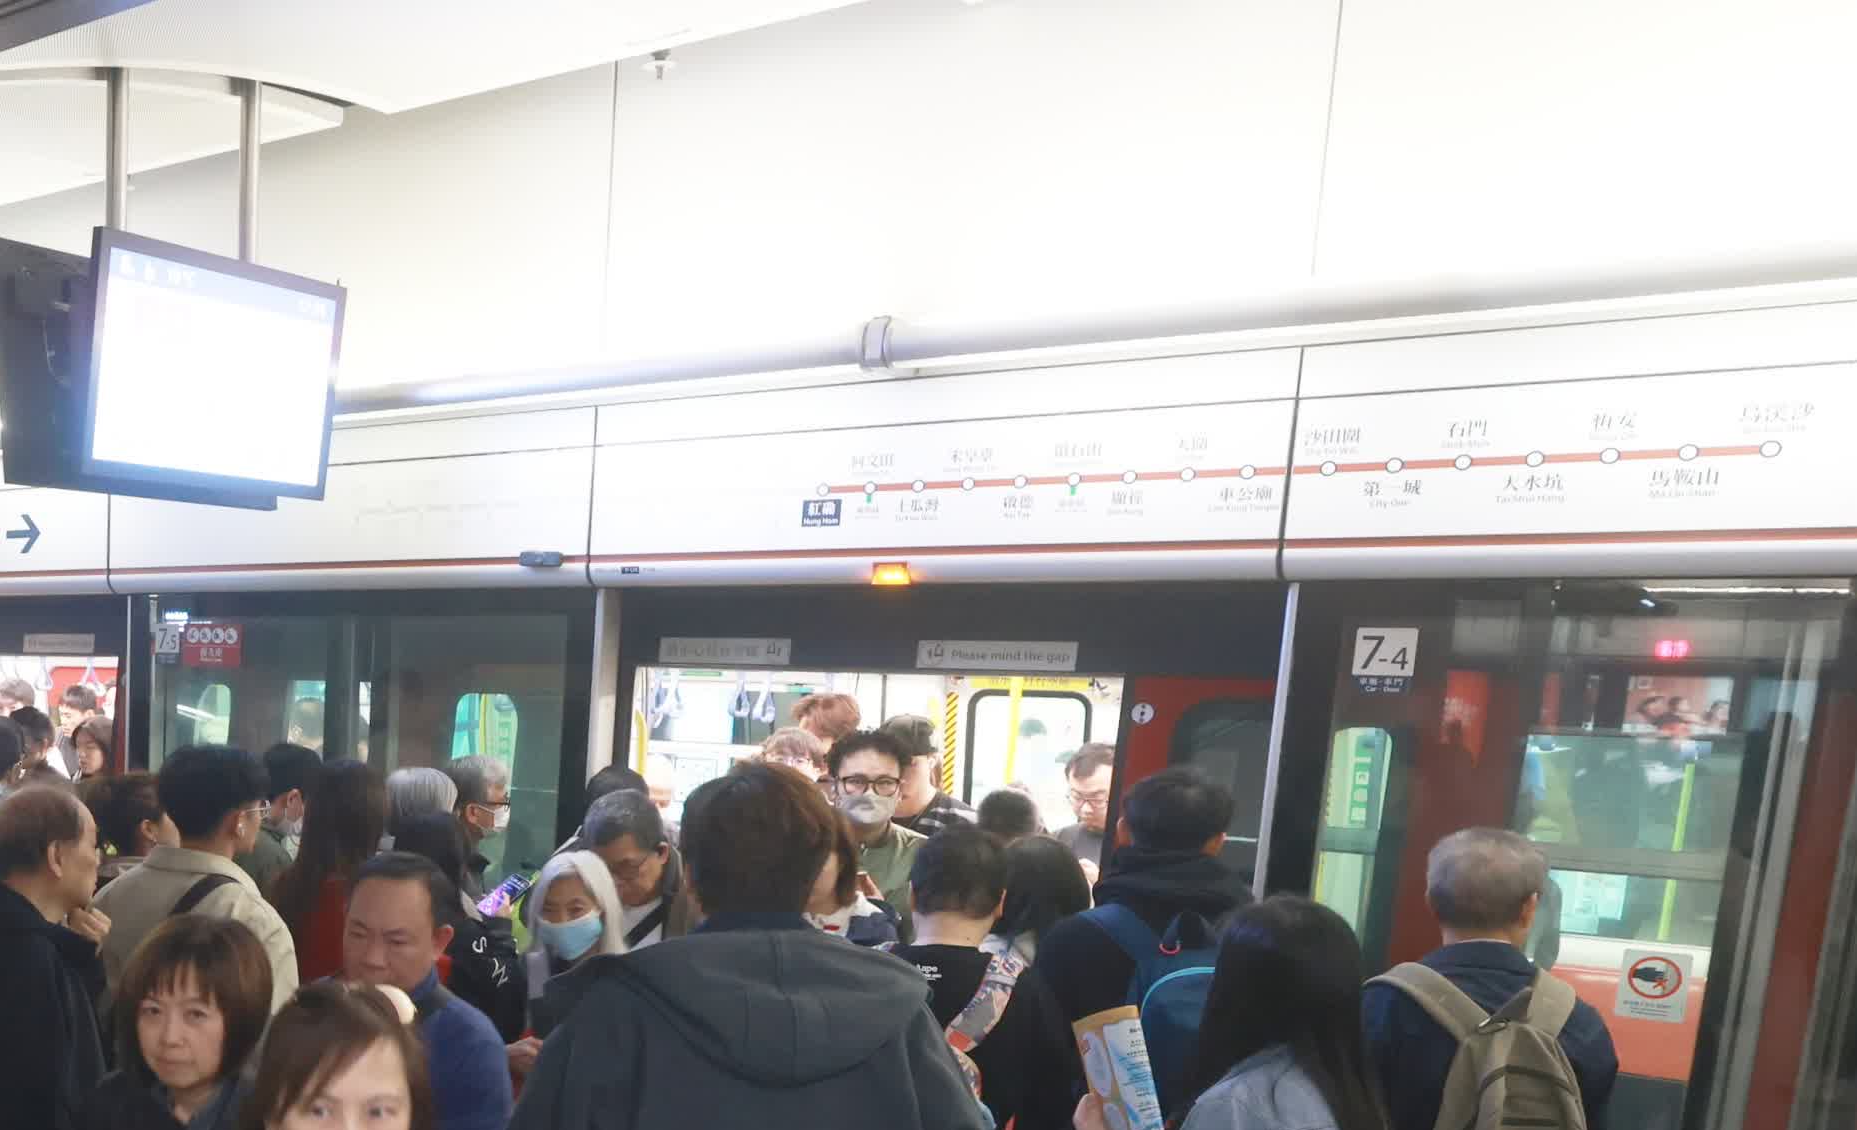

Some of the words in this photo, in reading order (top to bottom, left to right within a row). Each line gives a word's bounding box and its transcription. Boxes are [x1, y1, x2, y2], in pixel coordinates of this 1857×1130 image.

[1363, 479, 1423, 497] 第一城
[1503, 474, 1564, 491] 大水坑
[951, 649, 985, 660] Please
[990, 649, 1021, 661] mind
[1023, 650, 1042, 661] the
[1046, 652, 1070, 664] gap
[1361, 634, 1409, 671] 7-4
